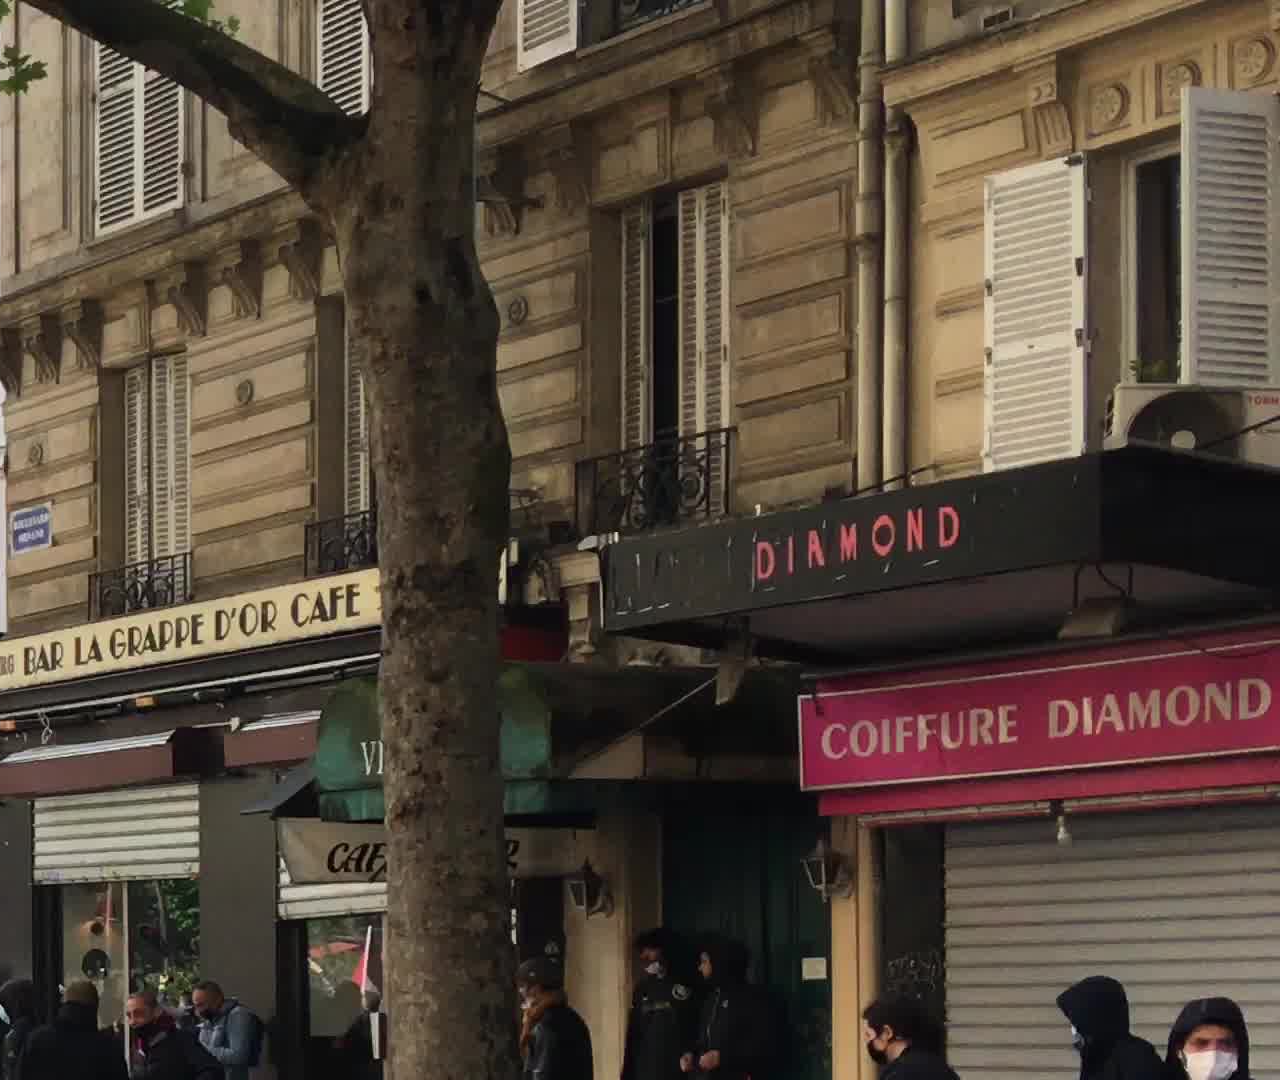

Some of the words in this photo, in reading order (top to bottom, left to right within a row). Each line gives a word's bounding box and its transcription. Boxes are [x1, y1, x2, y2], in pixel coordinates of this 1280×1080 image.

[755, 507, 960, 579] DIAMOND
[23, 640, 65, 676] BAR
[73, 626, 103, 665] LA
[108, 613, 205, 661] GRAPPE
[214, 600, 278, 640] D'OR
[291, 584, 360, 627] CAFE
[820, 704, 1019, 760] COIFFURE
[1047, 677, 1273, 740] DIAMOND
[359, 739, 384, 776] VI
[327, 842, 387, 883] CAF
